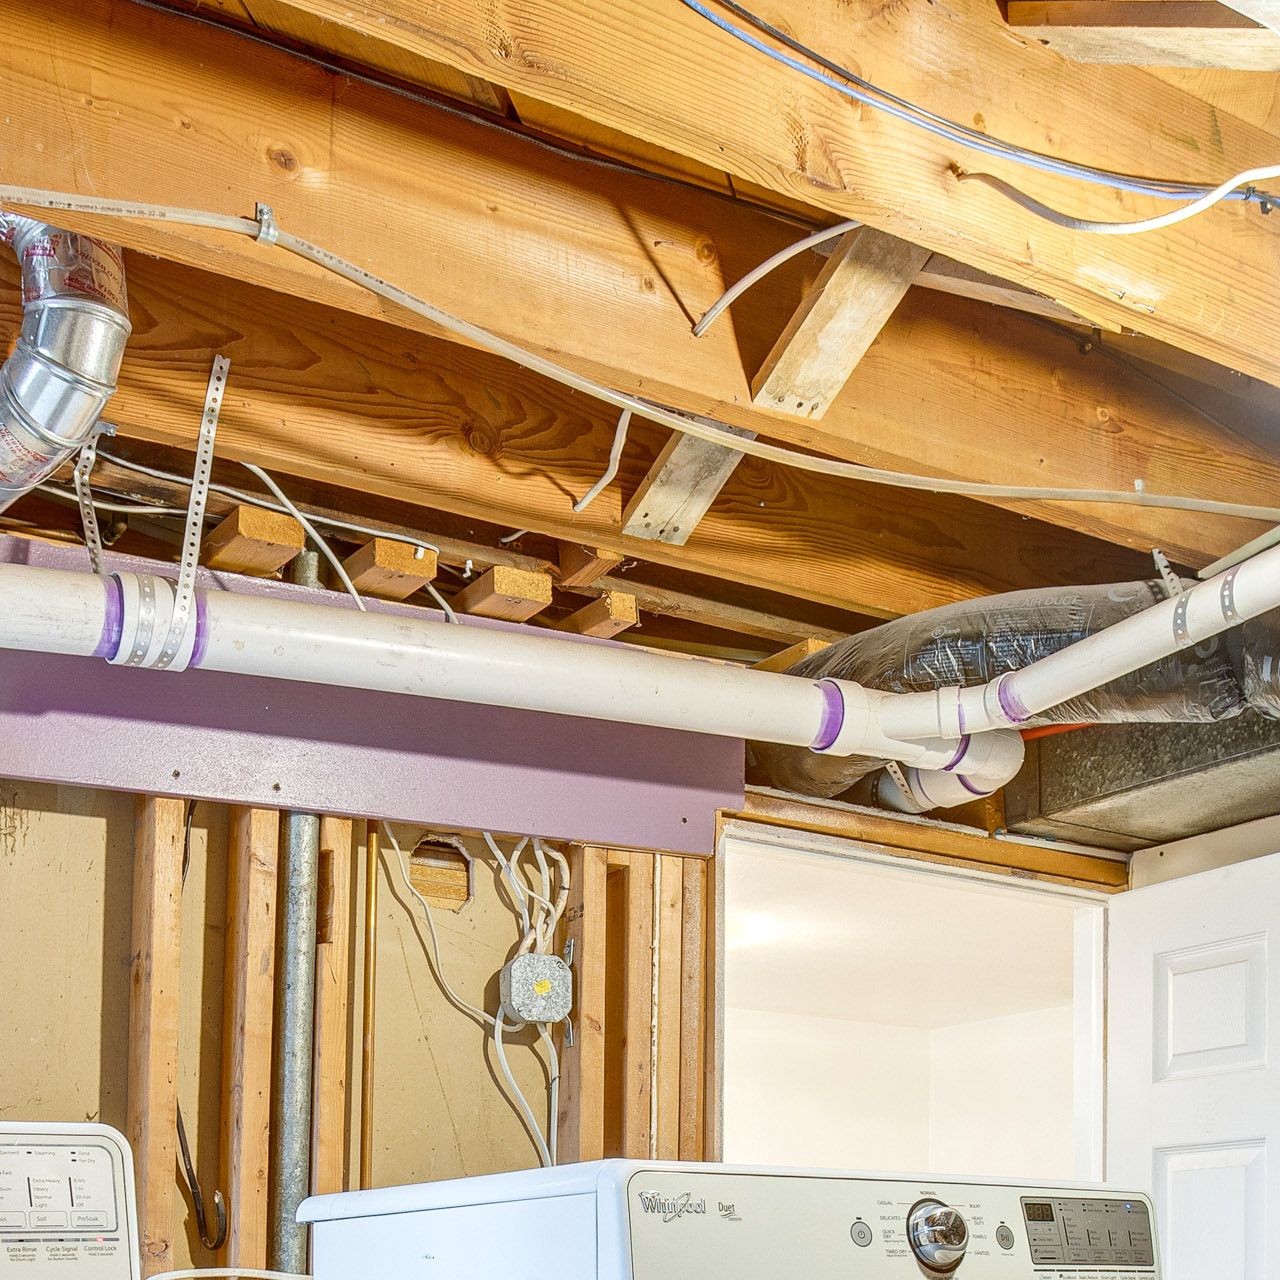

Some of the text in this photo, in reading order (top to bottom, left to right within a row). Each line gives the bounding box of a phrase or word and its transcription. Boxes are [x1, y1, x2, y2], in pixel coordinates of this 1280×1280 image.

[718, 1201, 735, 1212] Duet
[46, 1245, 79, 1254] Cycle Signal
[83, 1244, 104, 1252] Control
